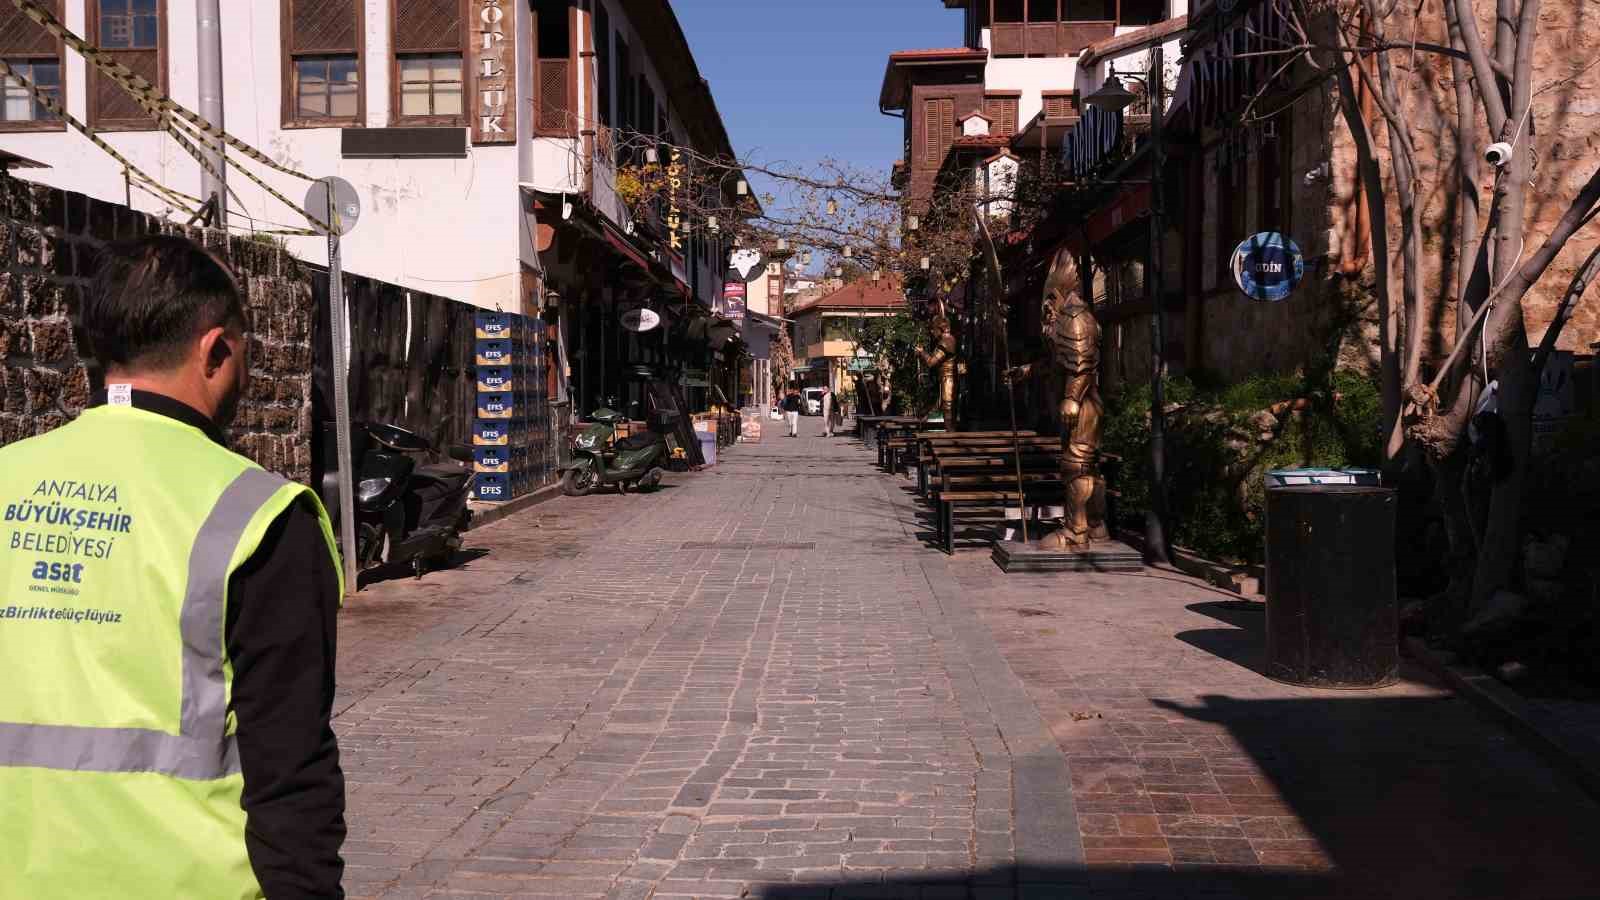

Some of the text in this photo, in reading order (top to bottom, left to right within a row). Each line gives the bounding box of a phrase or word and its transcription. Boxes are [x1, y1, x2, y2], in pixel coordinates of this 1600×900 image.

[33, 479, 118, 503] ANTALYA
[480, 486, 502, 495] EFES
[4, 499, 132, 533] BÜYÜKŞEHİR
[10, 531, 114, 559] BELEDİYESİ
[31, 560, 84, 583] asat
